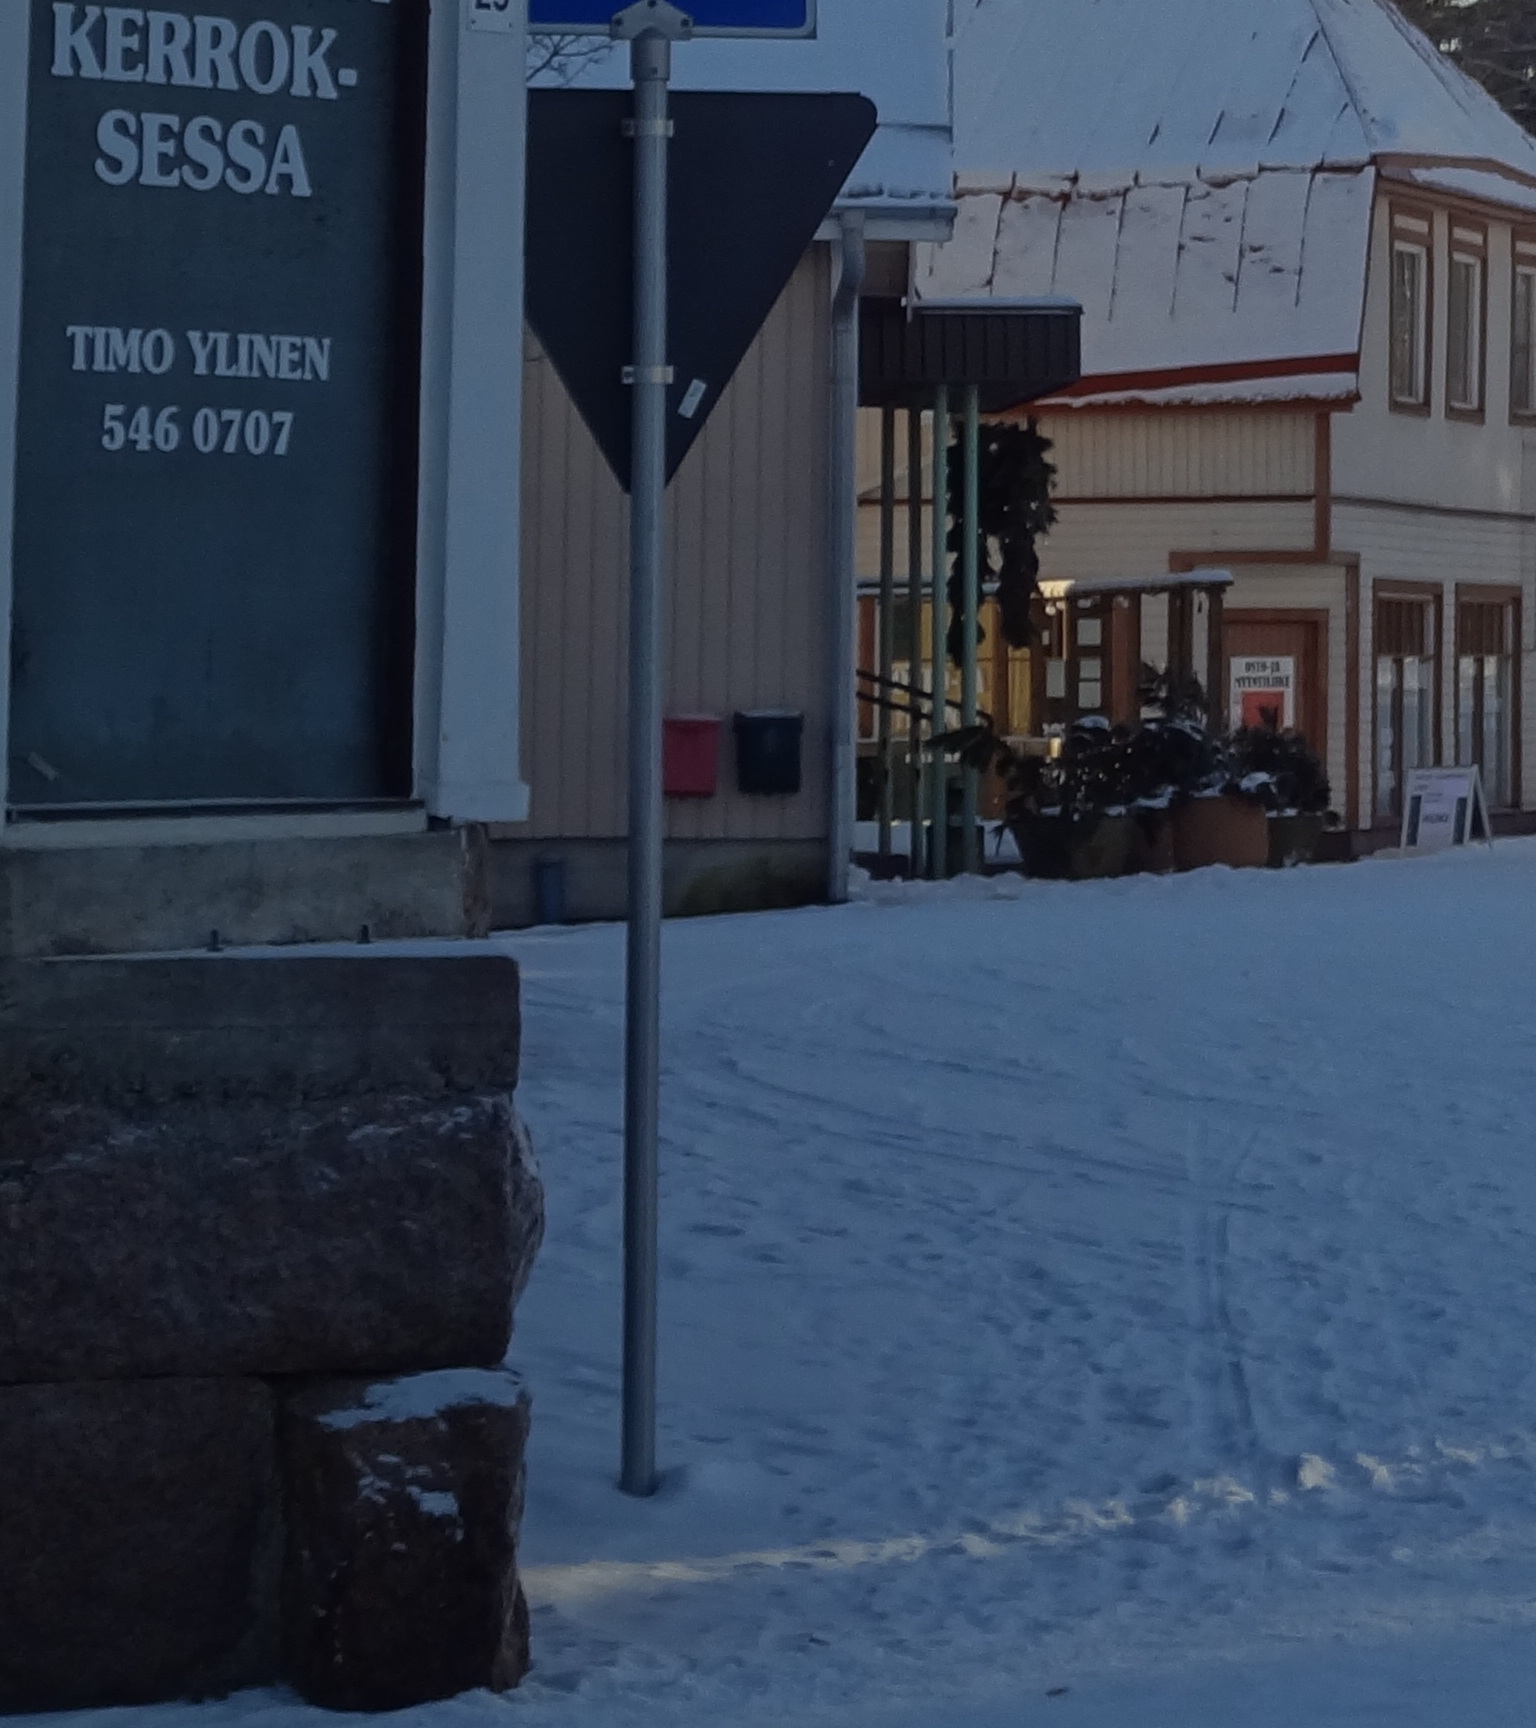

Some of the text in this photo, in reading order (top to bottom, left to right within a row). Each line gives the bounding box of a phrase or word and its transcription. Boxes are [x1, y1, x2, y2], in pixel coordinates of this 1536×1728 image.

[51, 2, 357, 99] KERROK-
[95, 110, 312, 197] SESSA
[66, 325, 331, 382] TIMO YLINEN
[101, 405, 294, 455] 546 0707
